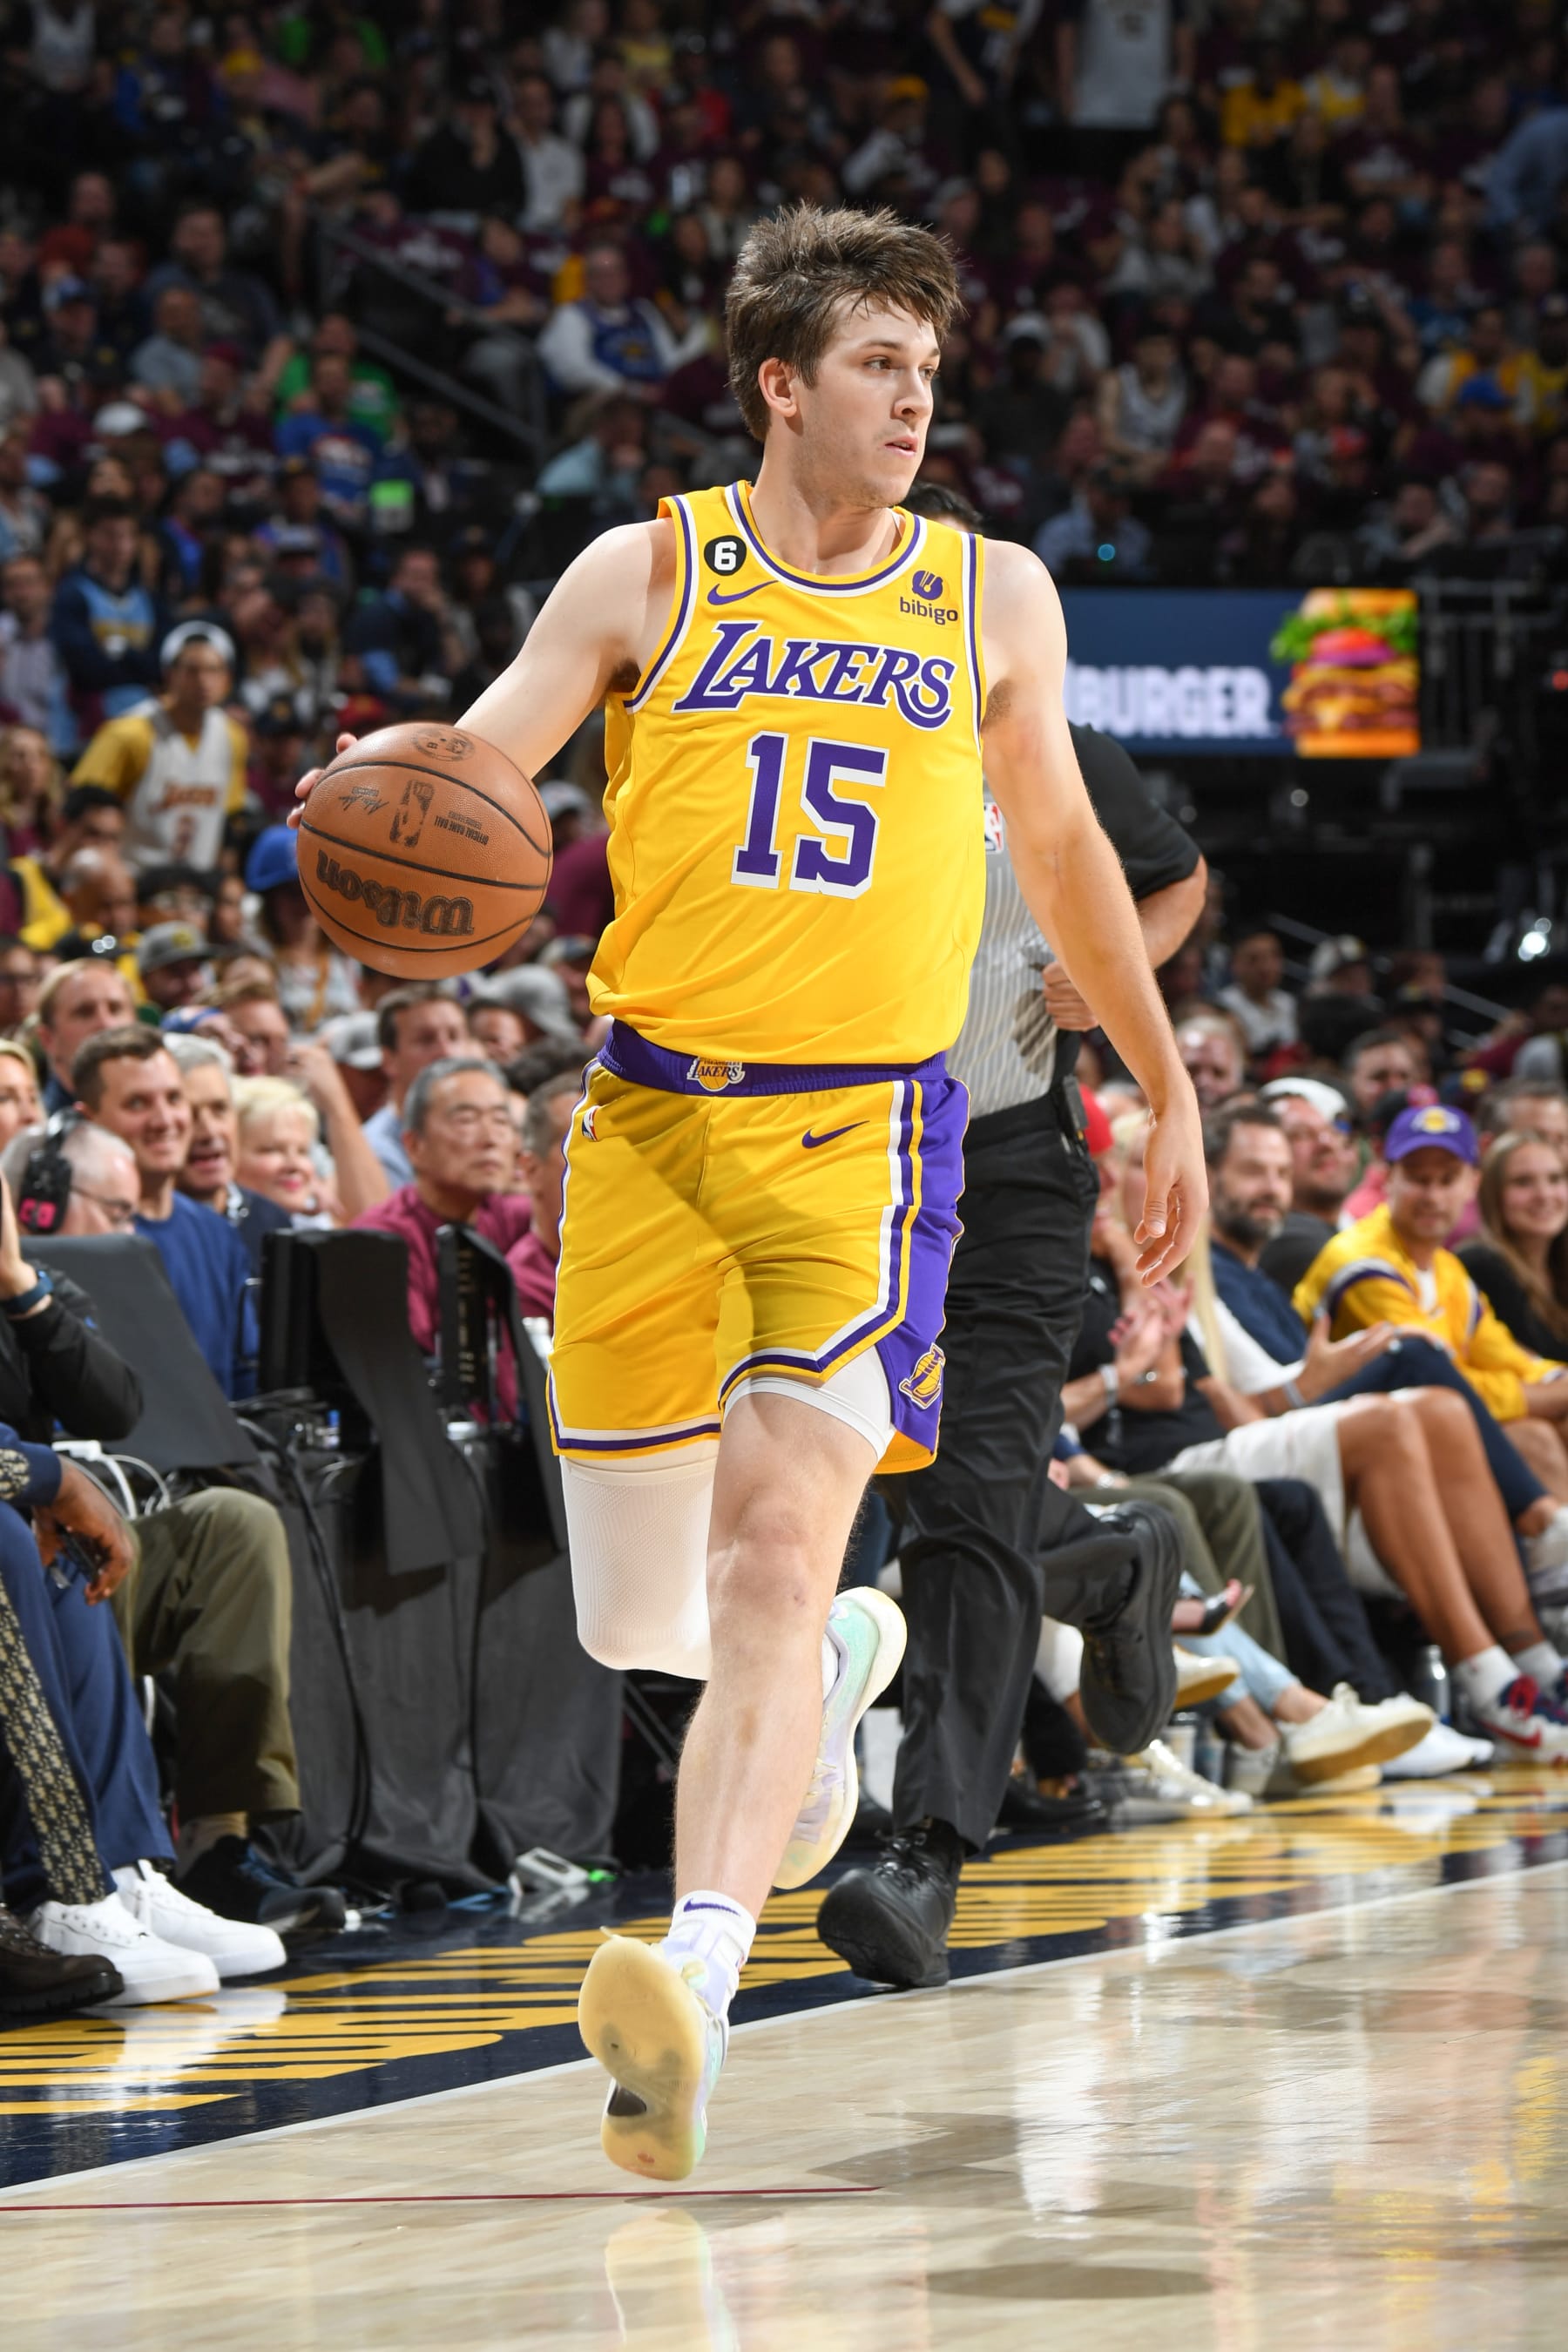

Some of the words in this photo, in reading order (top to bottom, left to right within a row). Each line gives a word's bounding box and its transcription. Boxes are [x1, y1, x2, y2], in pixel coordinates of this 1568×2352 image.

[714, 540, 738, 571] 6
[900, 596, 959, 625] bibigo
[671, 620, 957, 731] LAKERS
[1064, 659, 1271, 738] BURGER
[730, 729, 890, 901] 15
[316, 848, 475, 936] Wilson
[687, 1056, 746, 1084] LAKERS
